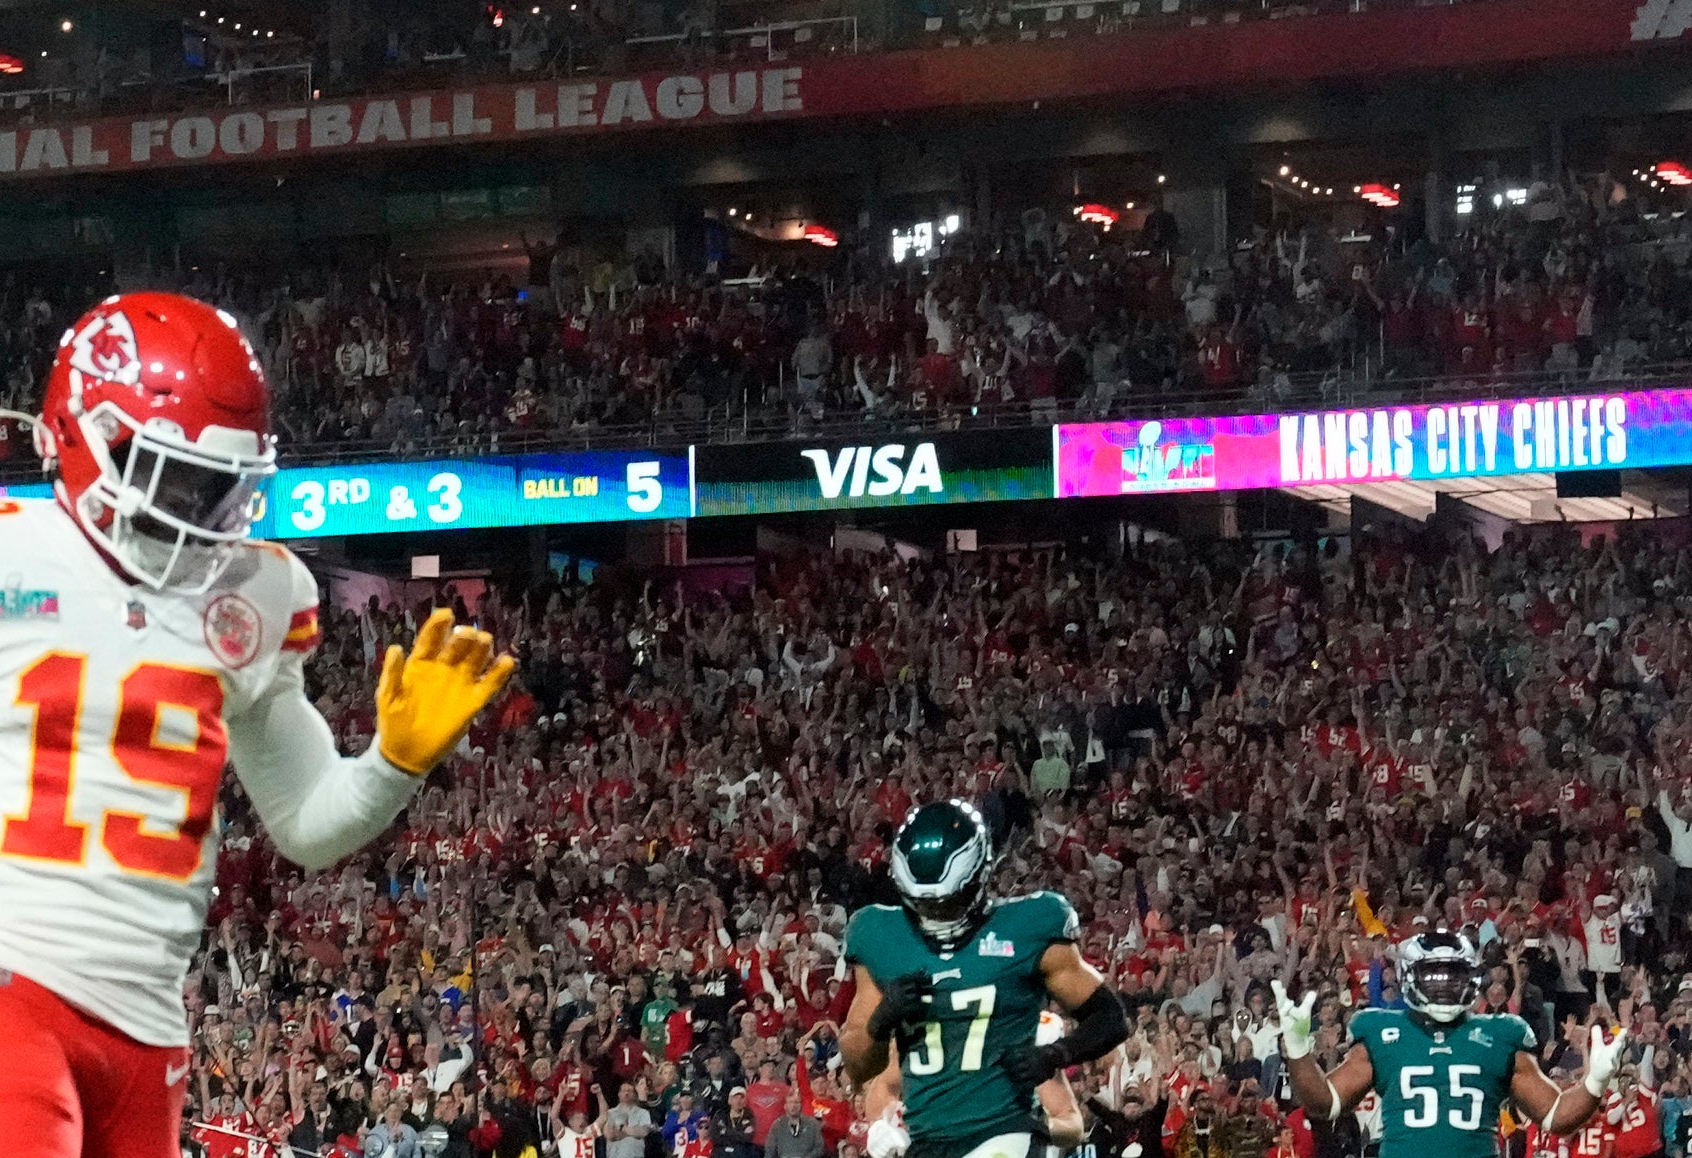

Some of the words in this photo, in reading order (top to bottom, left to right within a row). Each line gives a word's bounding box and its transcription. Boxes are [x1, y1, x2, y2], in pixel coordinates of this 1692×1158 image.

[130, 94, 492, 162] FOOTBALL
[514, 67, 803, 130] LEAGUE
[1279, 409, 1413, 482] KANSAS
[1427, 404, 1498, 474] CITY
[1513, 397, 1627, 469] CHIEFS
[523, 478, 571, 499] BALL
[573, 476, 598, 497] ON
[626, 461, 663, 513] 5
[801, 443, 943, 499] VISA
[427, 472, 463, 523] 3
[1400, 1064, 1484, 1130] 55
[574, 1137, 594, 1158] 15
[1578, 1128, 1601, 1155] 15
